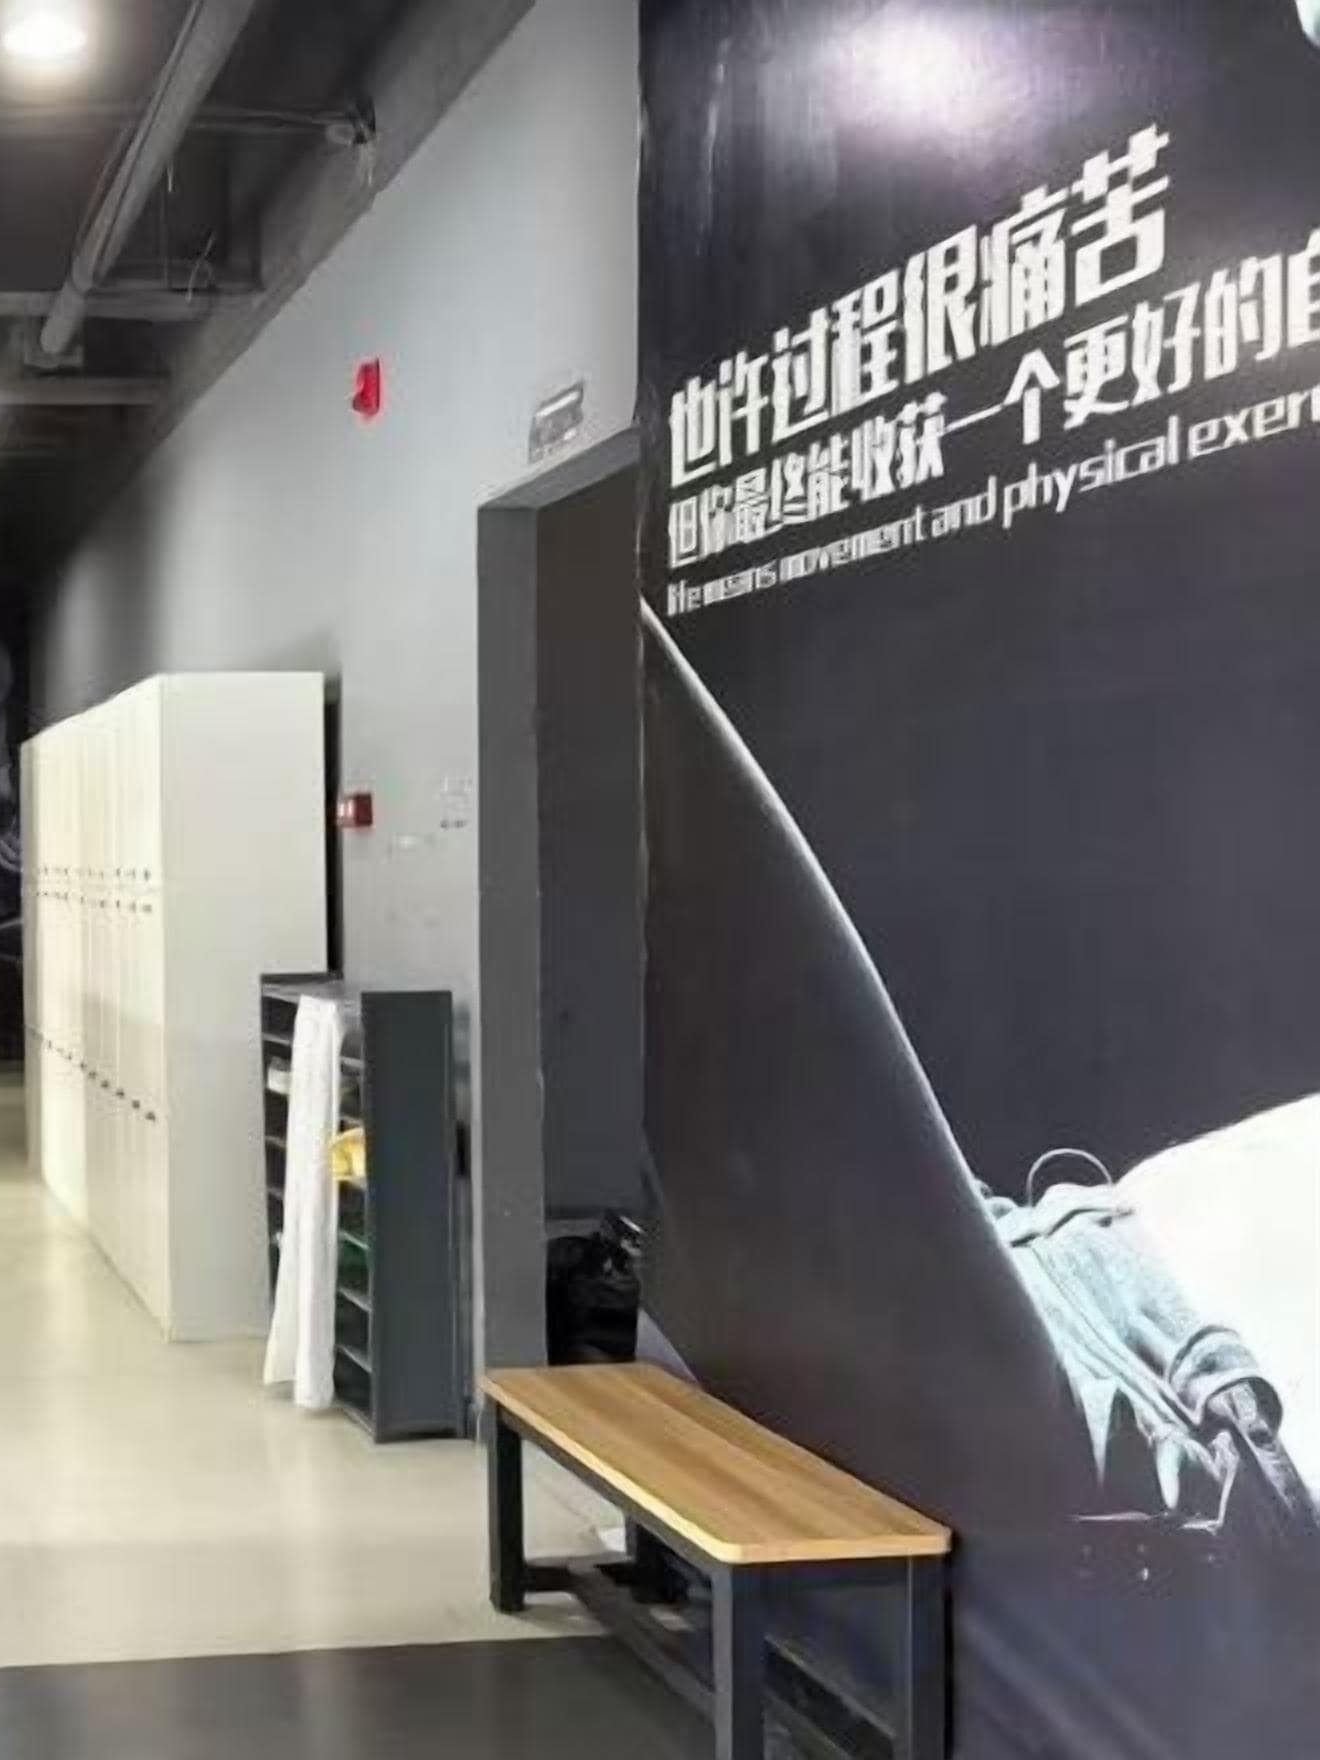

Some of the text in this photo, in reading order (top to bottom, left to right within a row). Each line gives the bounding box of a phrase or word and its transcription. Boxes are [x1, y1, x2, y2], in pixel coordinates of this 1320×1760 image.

[669, 124, 1169, 486] 也许过程很痛苦
[780, 505, 925, 582] movement
[932, 475, 995, 538] and
[1003, 414, 1180, 528] physical
